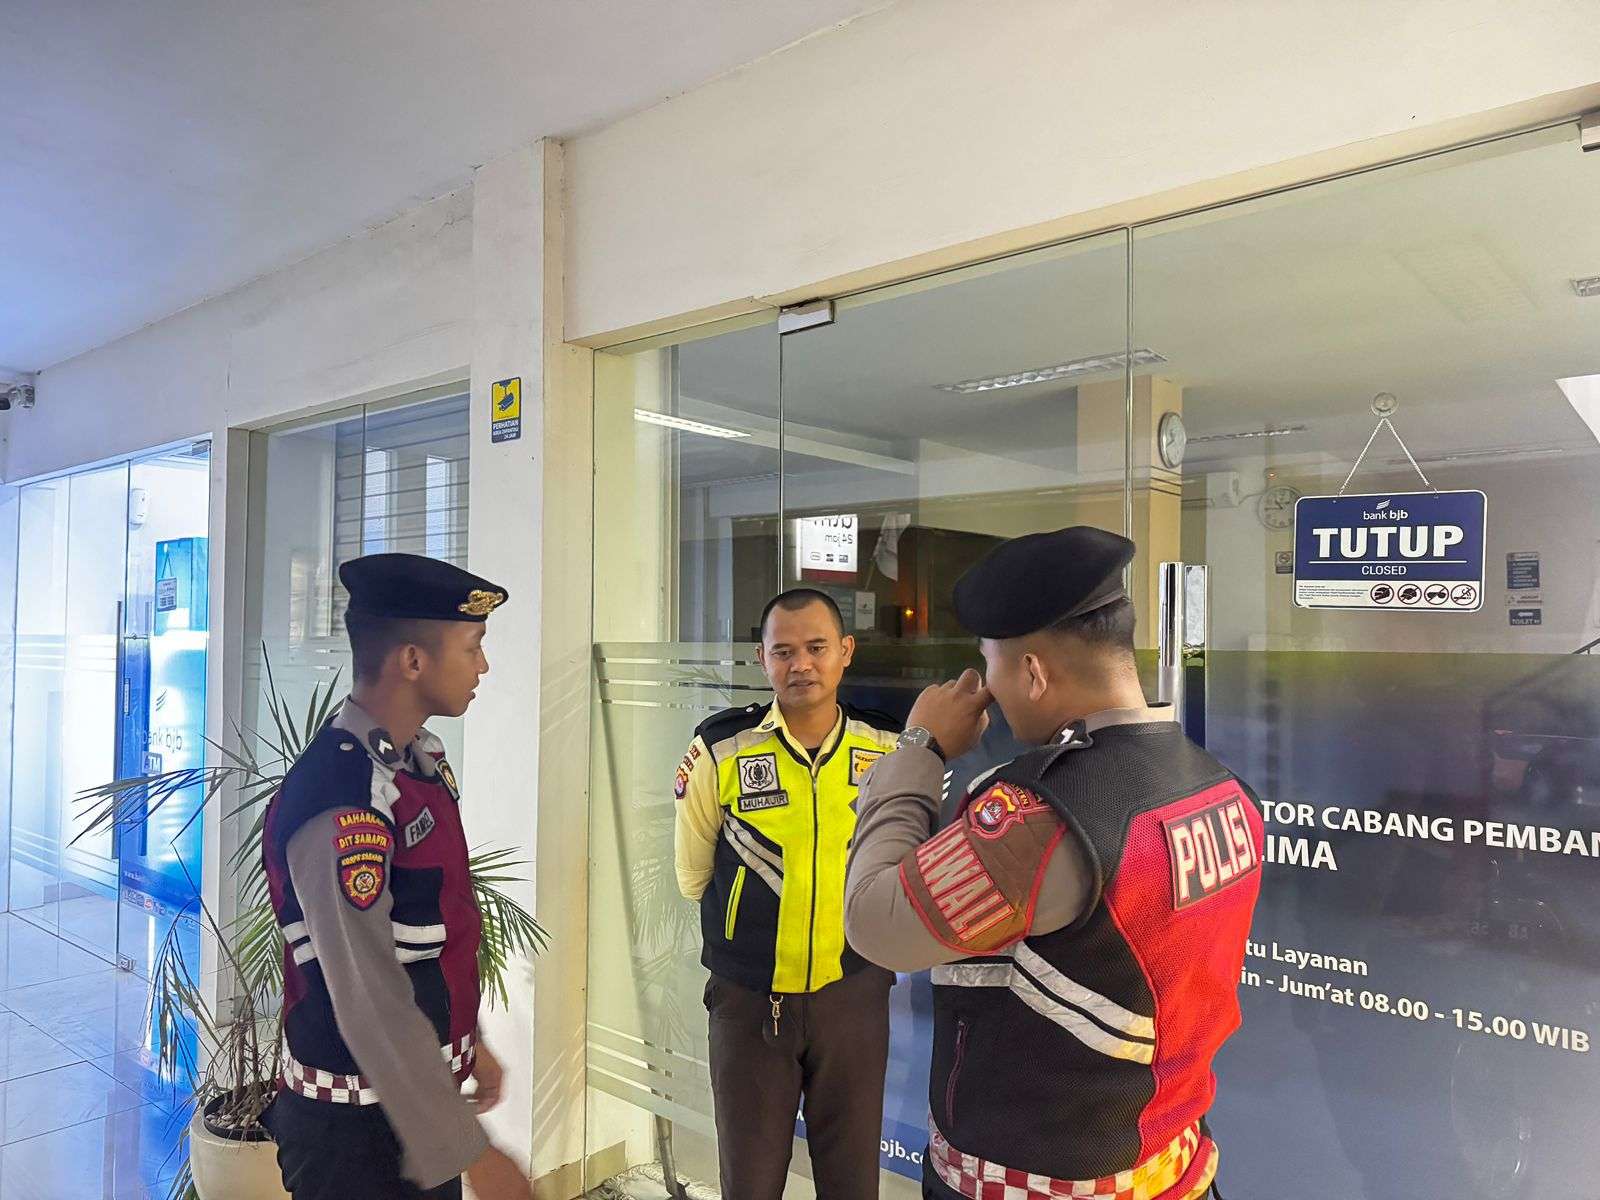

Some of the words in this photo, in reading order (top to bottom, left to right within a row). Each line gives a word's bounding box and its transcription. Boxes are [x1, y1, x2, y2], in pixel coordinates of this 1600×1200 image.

[1363, 511, 1388, 520] bank
[1389, 509, 1409, 521] bjb
[1312, 525, 1464, 558] TUTUP
[1361, 565, 1407, 575] CLOSED
[1260, 800, 1315, 827] TOR
[1321, 806, 1454, 842] CABANG
[1170, 800, 1257, 900] POLISI
[1262, 834, 1338, 871] IMA
[1272, 942, 1368, 976] Layanan
[1359, 990, 1429, 1021] 08.00
[1452, 1008, 1526, 1041] 15.00
[1531, 1022, 1590, 1054] WIB
